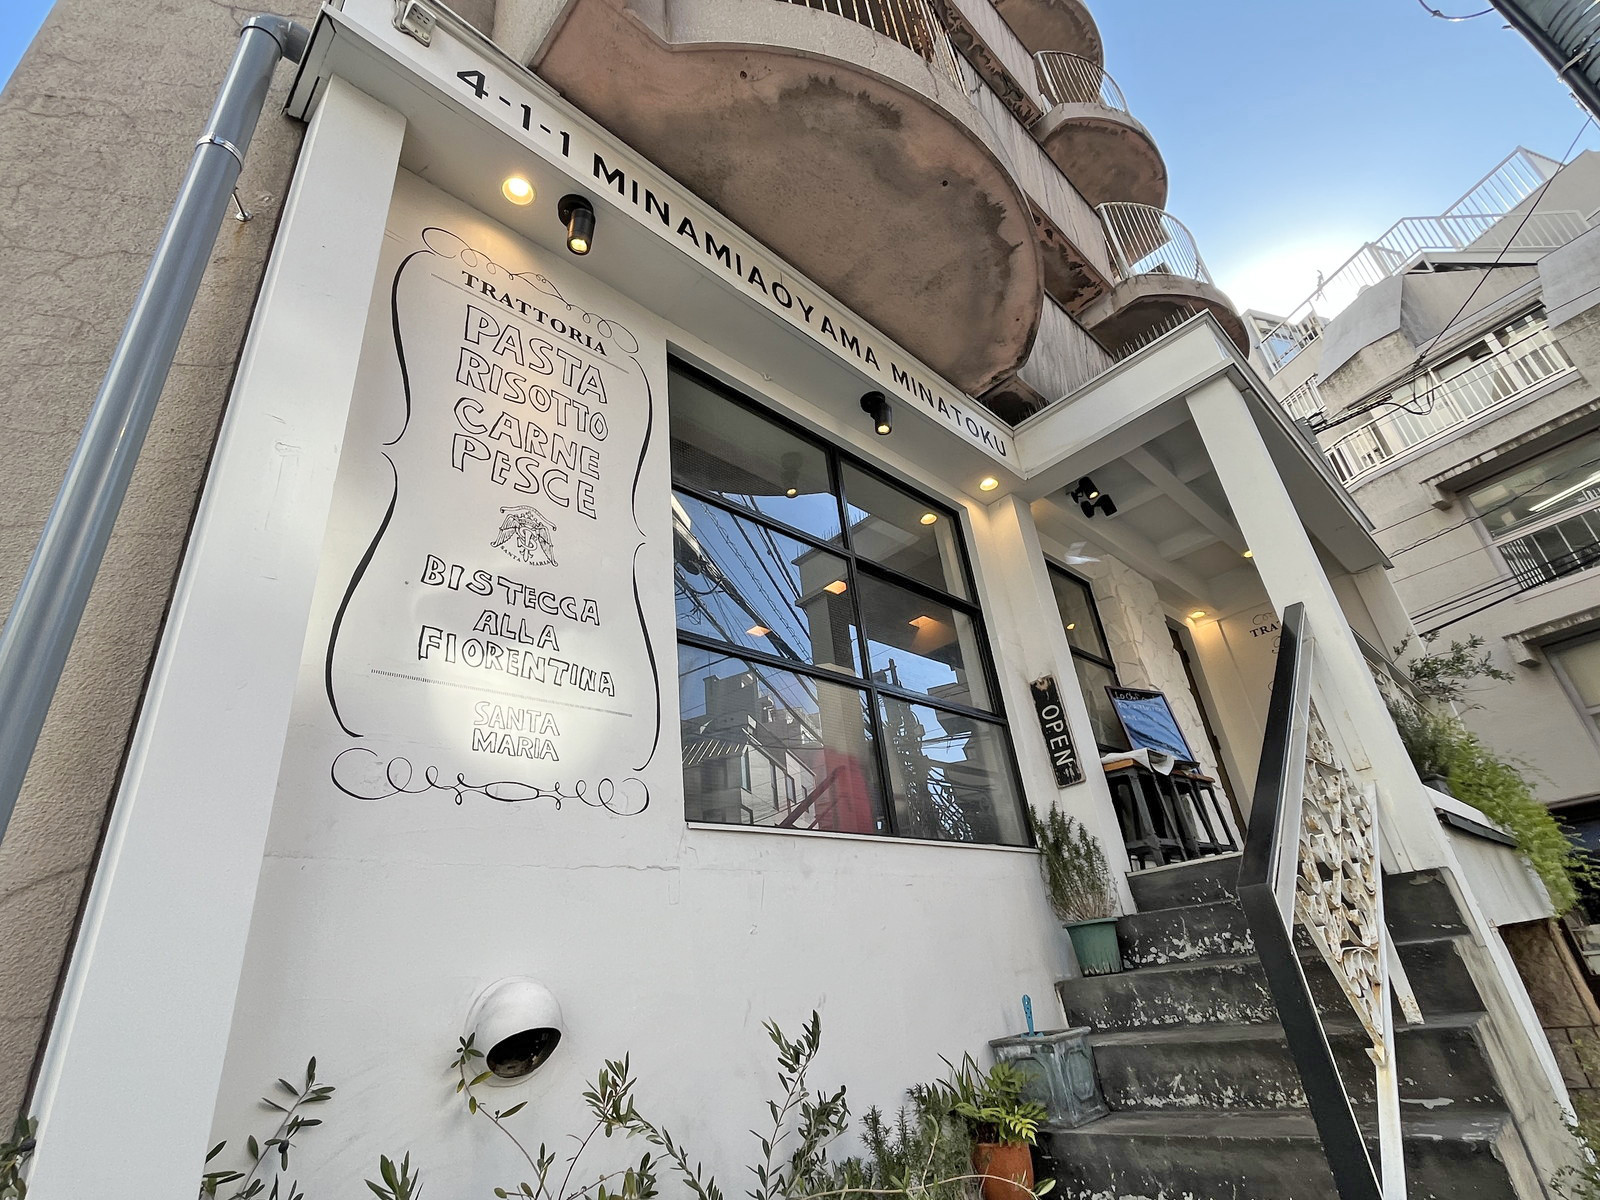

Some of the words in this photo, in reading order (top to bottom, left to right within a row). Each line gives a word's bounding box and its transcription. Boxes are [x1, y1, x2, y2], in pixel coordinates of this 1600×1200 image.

[456, 69, 571, 158] 4-1-1
[593, 152, 881, 372] MINAMIAOYAMA
[890, 362, 1007, 457] MINATOKU
[461, 270, 608, 356] TRATTORIA
[464, 304, 608, 404] PASTA
[456, 347, 609, 441] RISOTTO
[452, 433, 597, 520] PESCE
[453, 397, 600, 480] CARNE
[421, 554, 600, 626] BISTECCA
[418, 625, 615, 697] FIORENTINA
[473, 610, 560, 651] ALLA
[472, 728, 560, 761] MARIA
[473, 701, 560, 736] SANTA
[1041, 704, 1074, 768] OPEN
